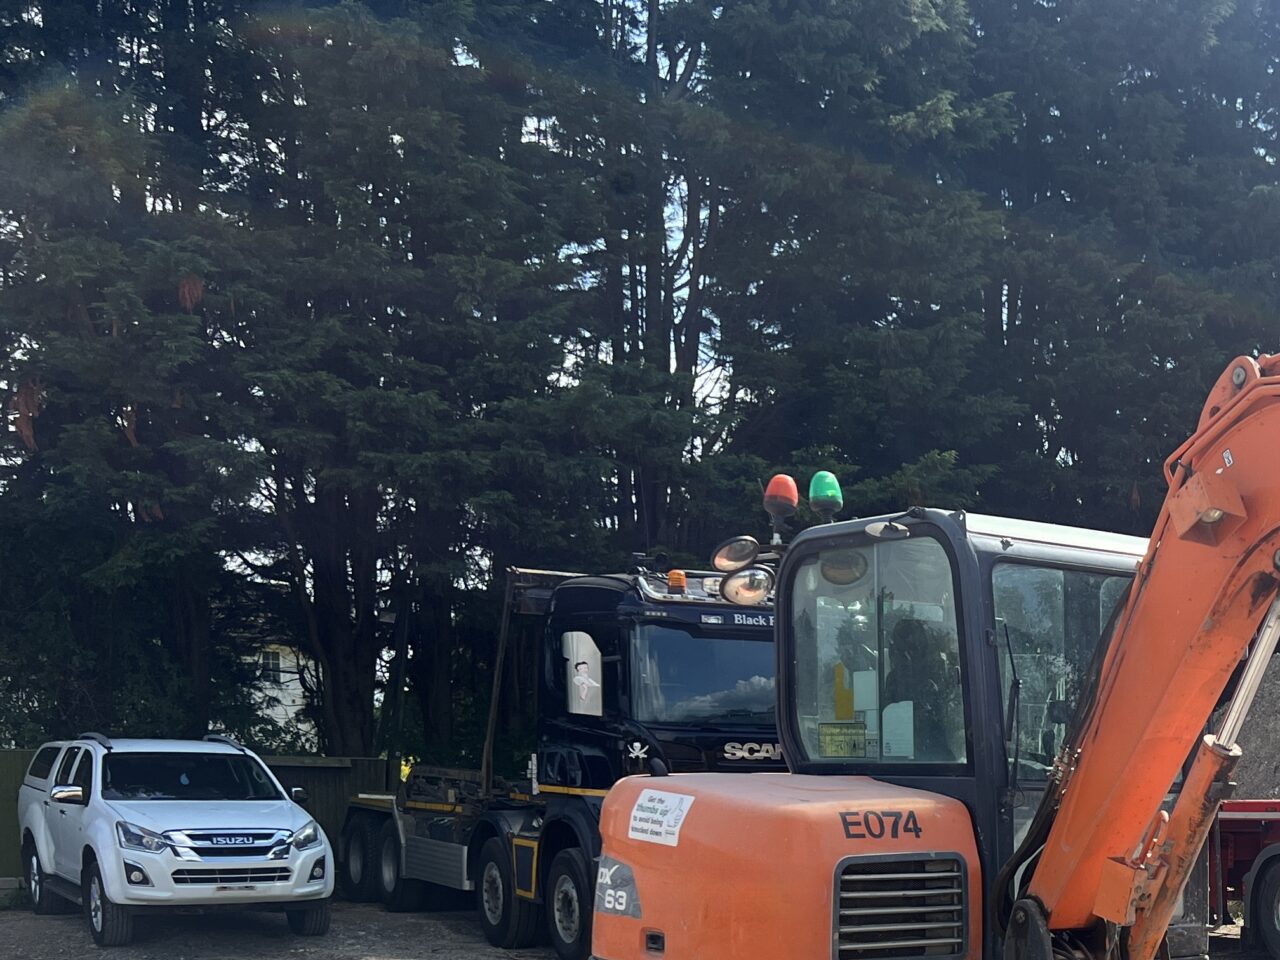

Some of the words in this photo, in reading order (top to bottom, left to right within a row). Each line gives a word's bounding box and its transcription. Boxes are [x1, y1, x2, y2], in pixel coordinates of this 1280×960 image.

[733, 613, 767, 626] Black
[838, 810, 922, 839] E074
[212, 836, 253, 845] ISUZU
[605, 889, 627, 910] 63
